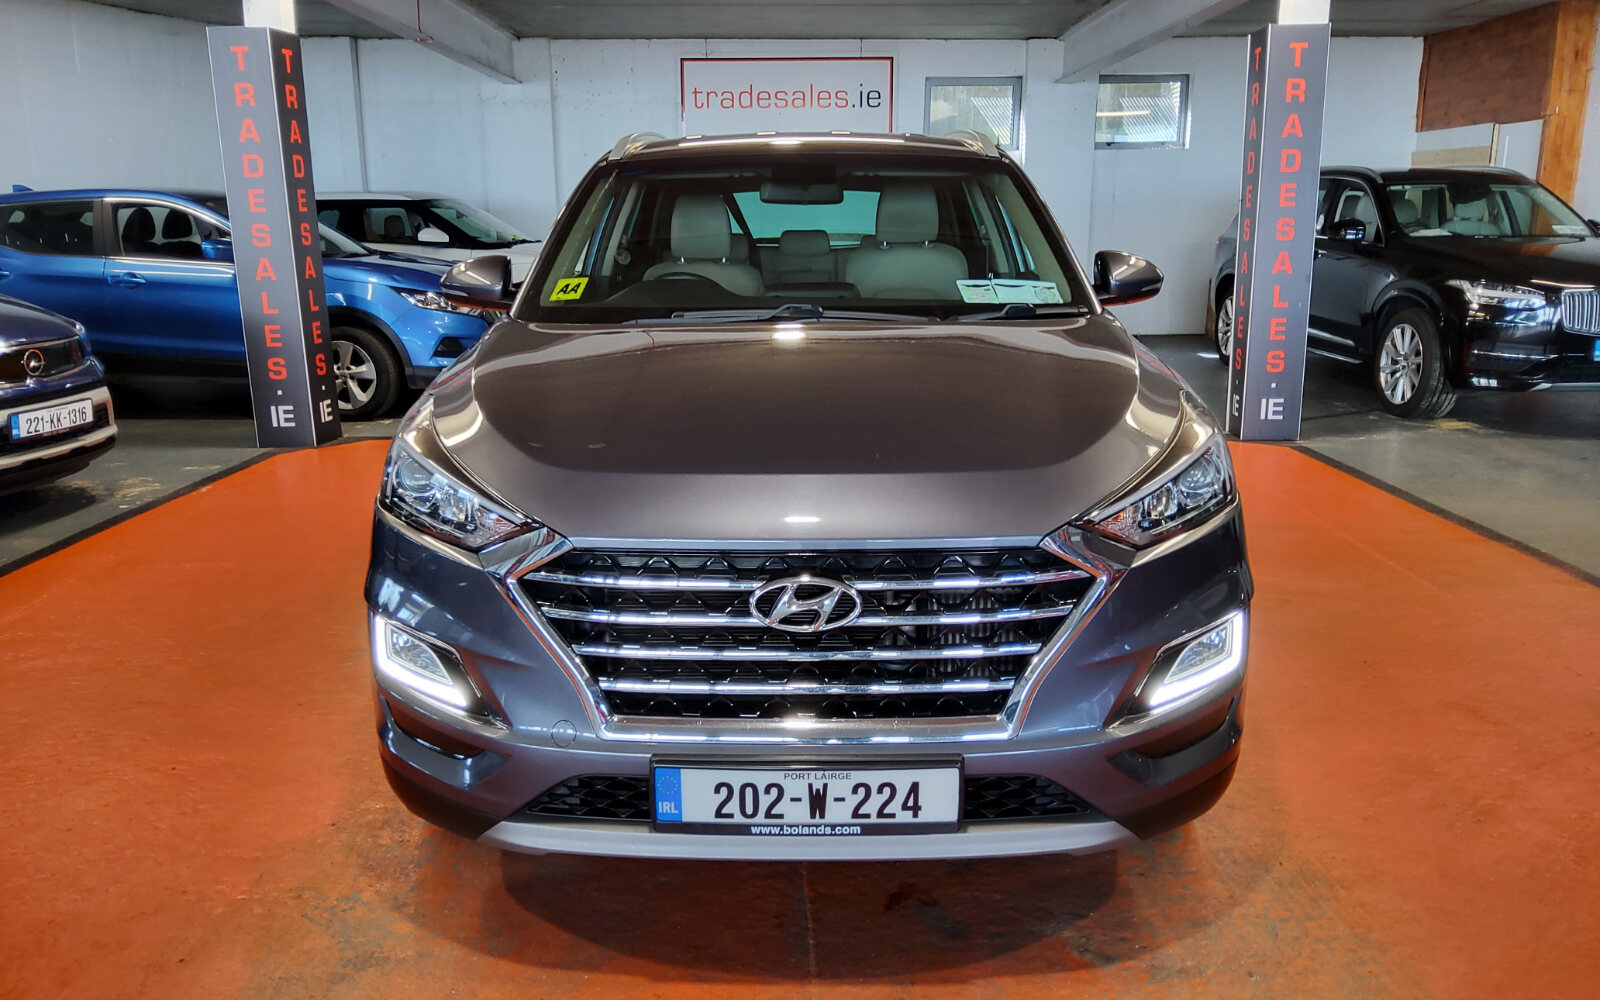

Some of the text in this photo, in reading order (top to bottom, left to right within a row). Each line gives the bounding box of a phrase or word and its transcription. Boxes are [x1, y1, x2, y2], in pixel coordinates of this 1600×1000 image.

[692, 83, 882, 109] tradesales.ie
[556, 282, 582, 296] AA
[25, 406, 87, 435] 221-KK-1316
[783, 772, 812, 781] PORT
[658, 801, 679, 814] IRL
[713, 781, 922, 820] 202-W-224
[750, 824, 861, 835] www.bolands.com
